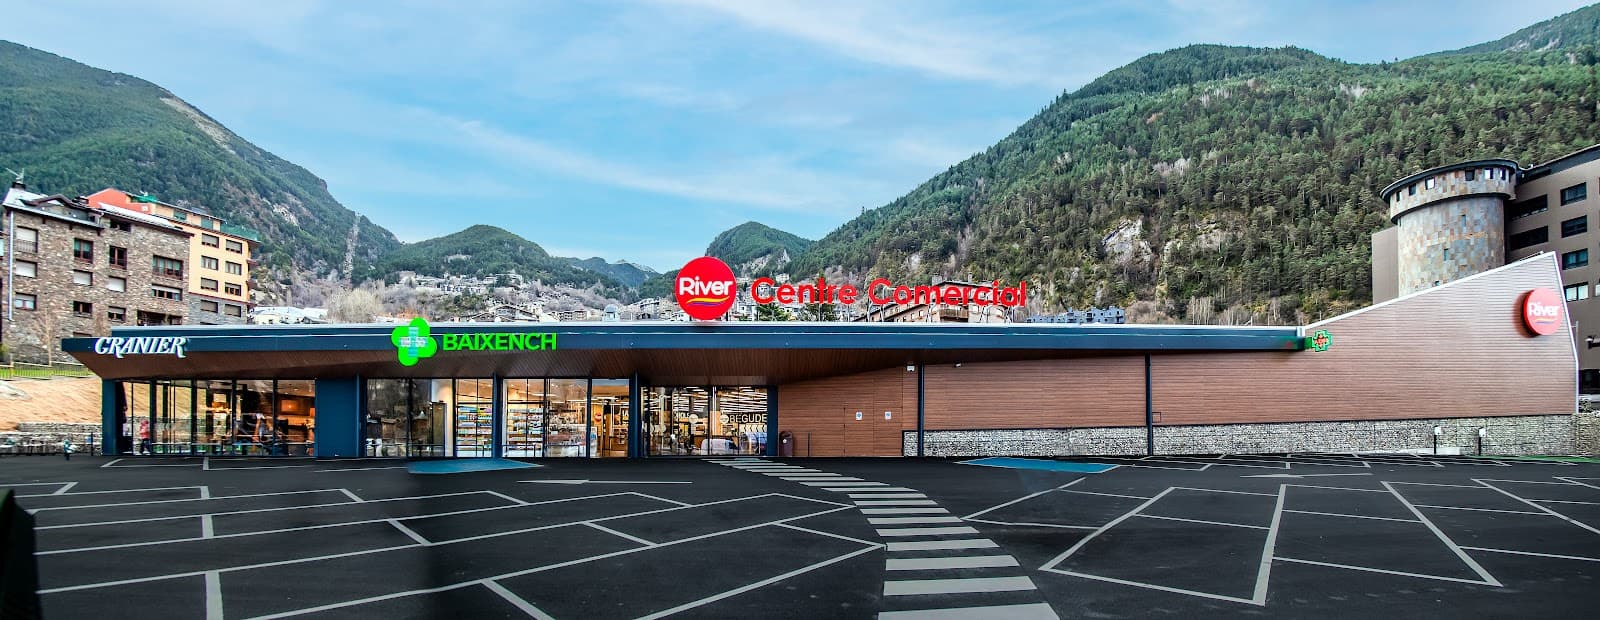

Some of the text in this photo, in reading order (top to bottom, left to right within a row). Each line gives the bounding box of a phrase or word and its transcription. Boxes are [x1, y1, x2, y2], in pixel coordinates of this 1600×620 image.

[679, 276, 1028, 307] River Centre Comercial
[1527, 302, 1561, 316] River
[94, 336, 187, 359] GRANIER
[442, 332, 557, 351] BAIXENCH
